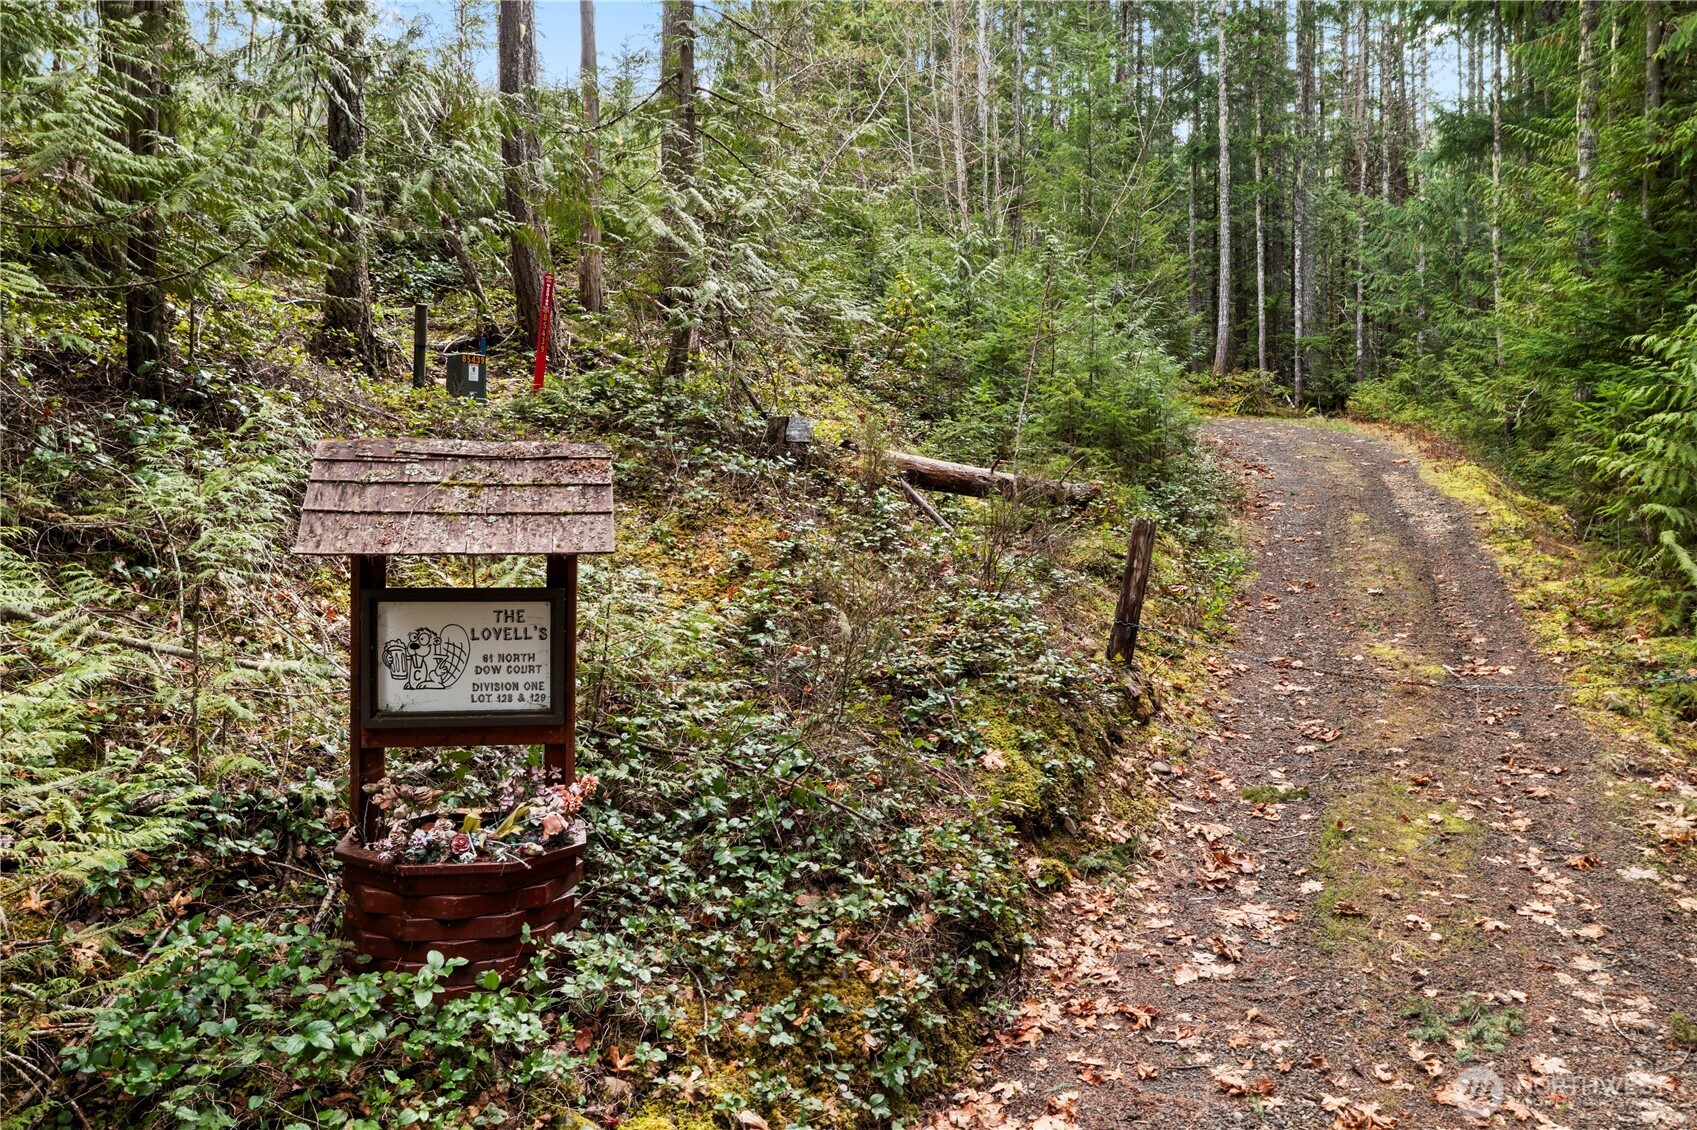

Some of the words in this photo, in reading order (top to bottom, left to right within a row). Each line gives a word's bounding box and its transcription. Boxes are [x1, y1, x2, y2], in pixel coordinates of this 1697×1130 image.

[540, 313, 548, 353] 85439
[461, 355, 485, 364] 85439
[493, 609, 526, 623] THE
[470, 626, 548, 641] LOVELL'S
[482, 654, 493, 663] 61
[498, 652, 536, 663] NORTH
[474, 665, 502, 675] DOW
[506, 665, 542, 674] COURT
[413, 670, 422, 682] C
[472, 682, 519, 692] DIVISION
[523, 681, 545, 691] ONE
[497, 694, 513, 703] 128
[517, 693, 526, 702] &
[530, 693, 547, 702] 129
